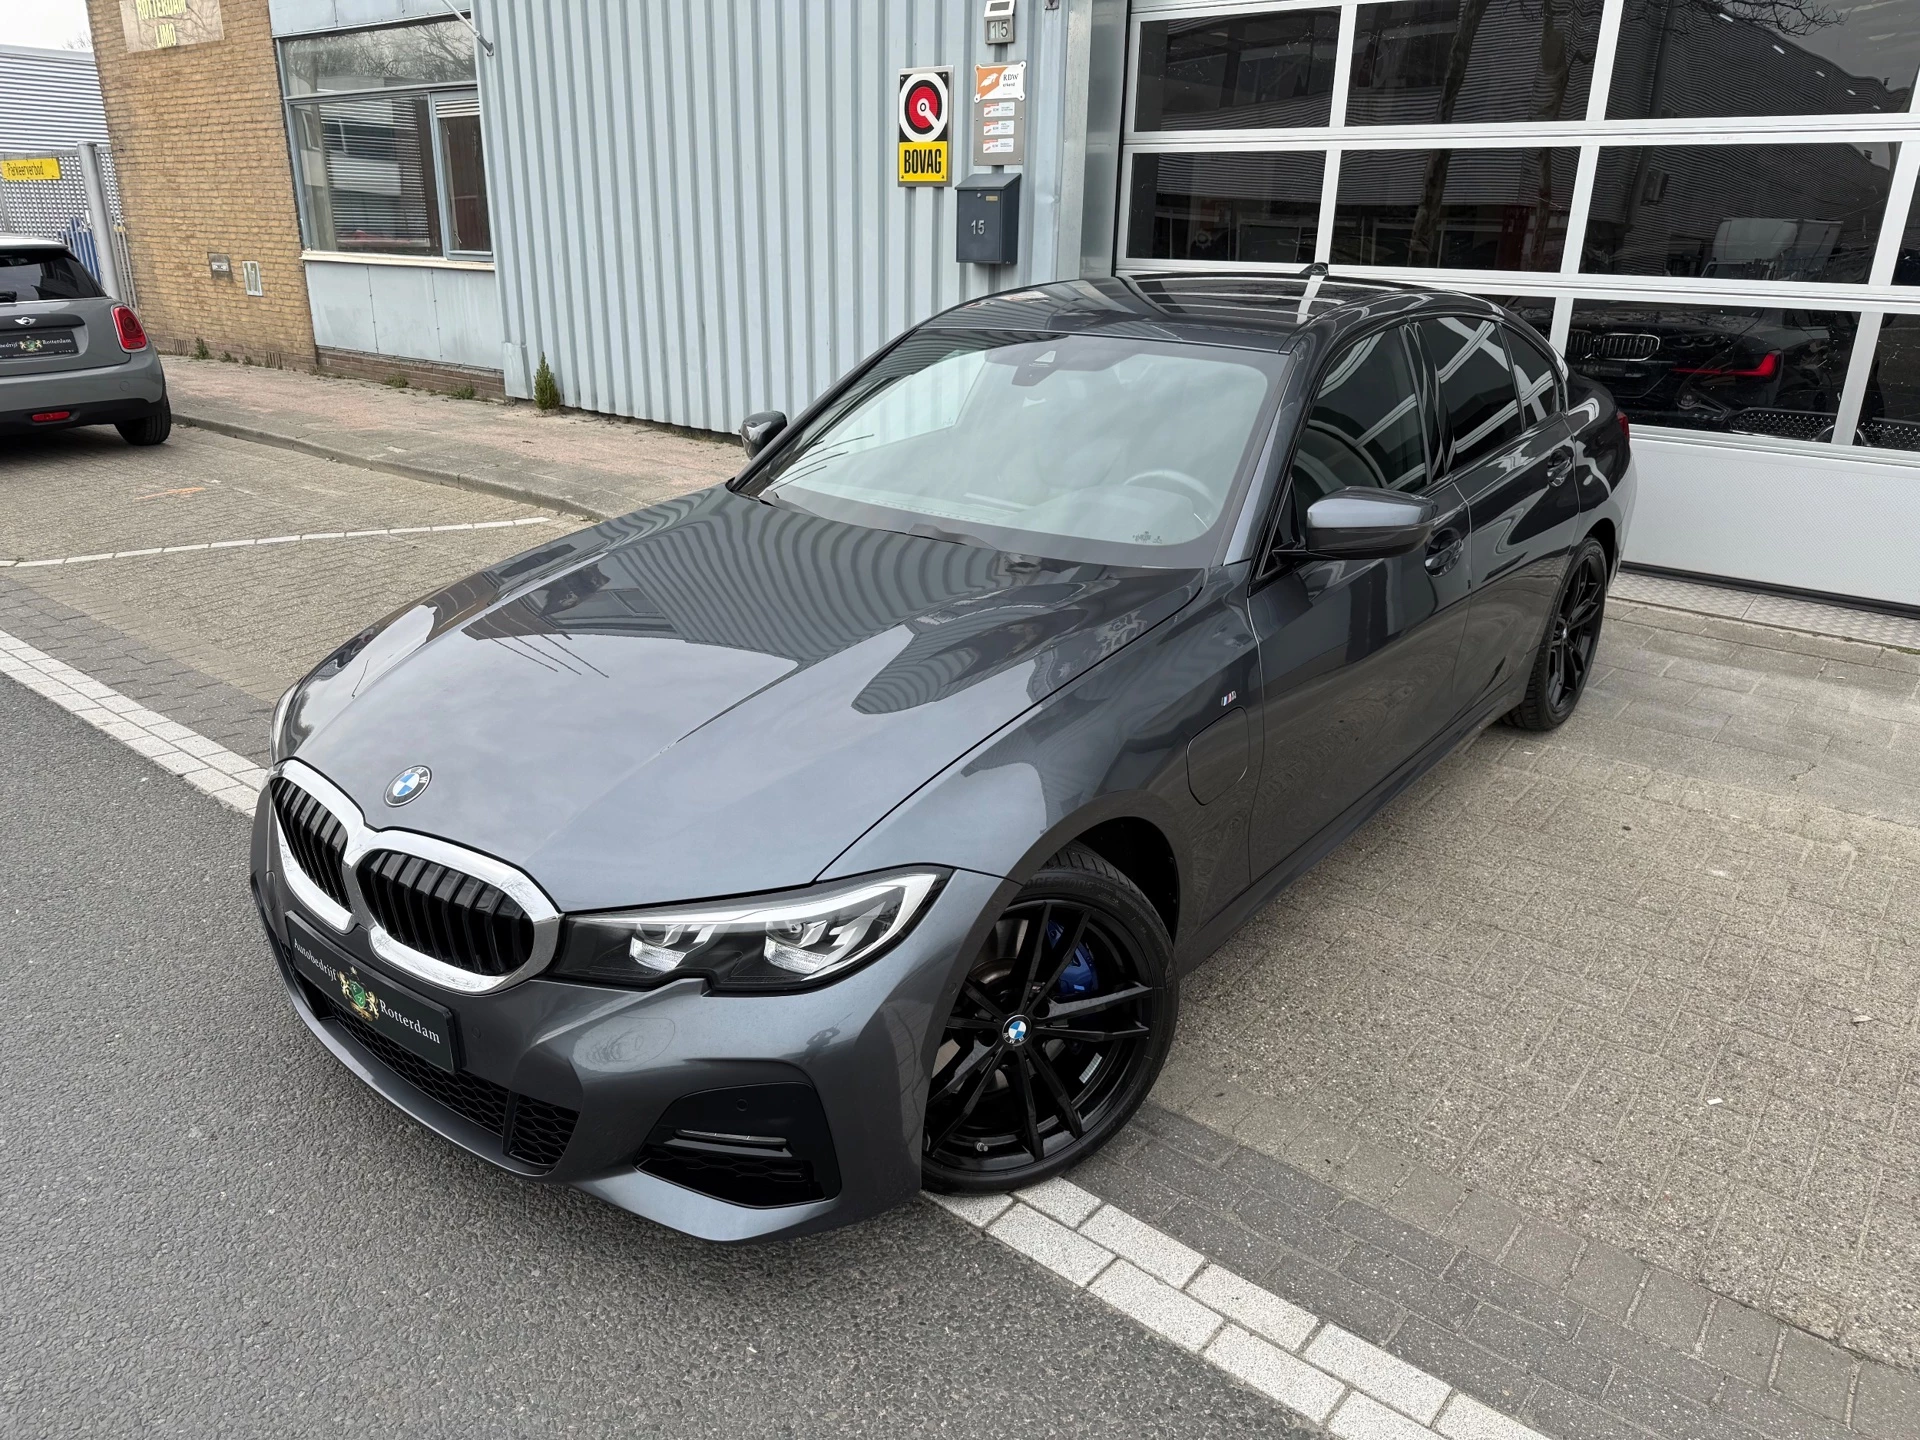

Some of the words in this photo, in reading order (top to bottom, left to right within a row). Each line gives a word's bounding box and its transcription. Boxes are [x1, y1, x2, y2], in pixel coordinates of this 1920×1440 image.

[154, 23, 177, 48] LIMO
[991, 21, 1008, 38] 15
[904, 149, 942, 174] BOVAG
[971, 220, 985, 235] 15
[294, 938, 338, 982] Autobedrijf
[379, 999, 441, 1044] Rotterdam
